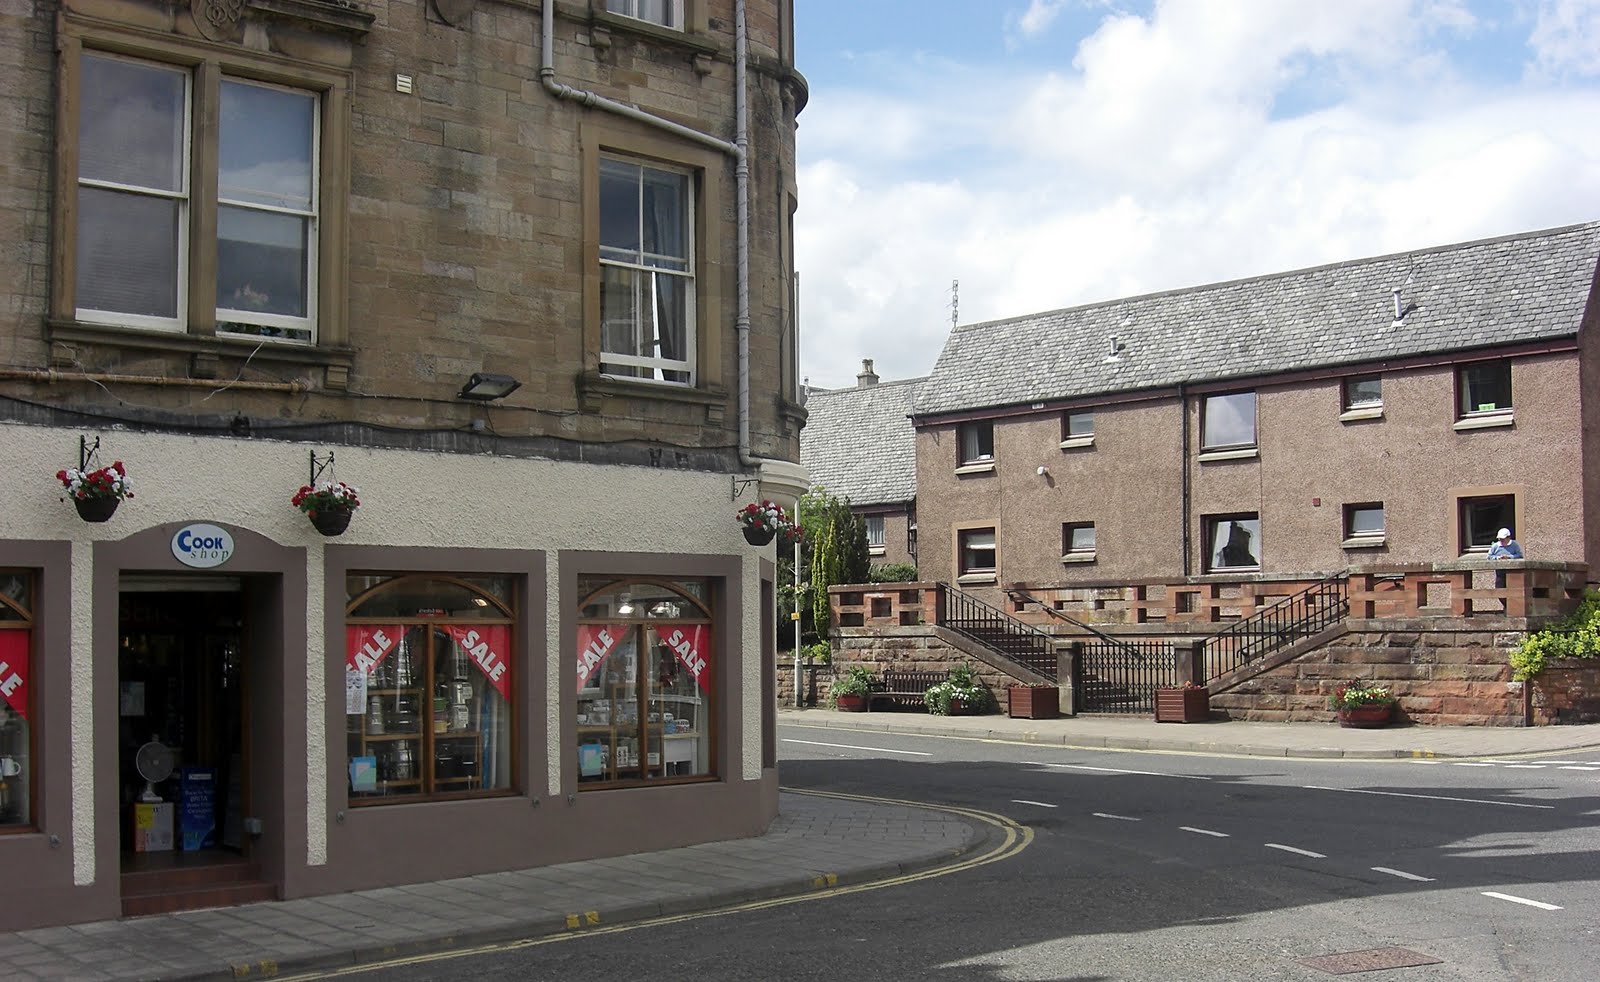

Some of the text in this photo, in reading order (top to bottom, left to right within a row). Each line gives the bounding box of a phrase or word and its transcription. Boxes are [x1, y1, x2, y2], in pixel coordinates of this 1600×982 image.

[191, 547, 229, 561] shop
[346, 629, 392, 673] ALE
[461, 630, 507, 682] SALE
[577, 630, 615, 680] SALE
[668, 630, 706, 676] SALE
